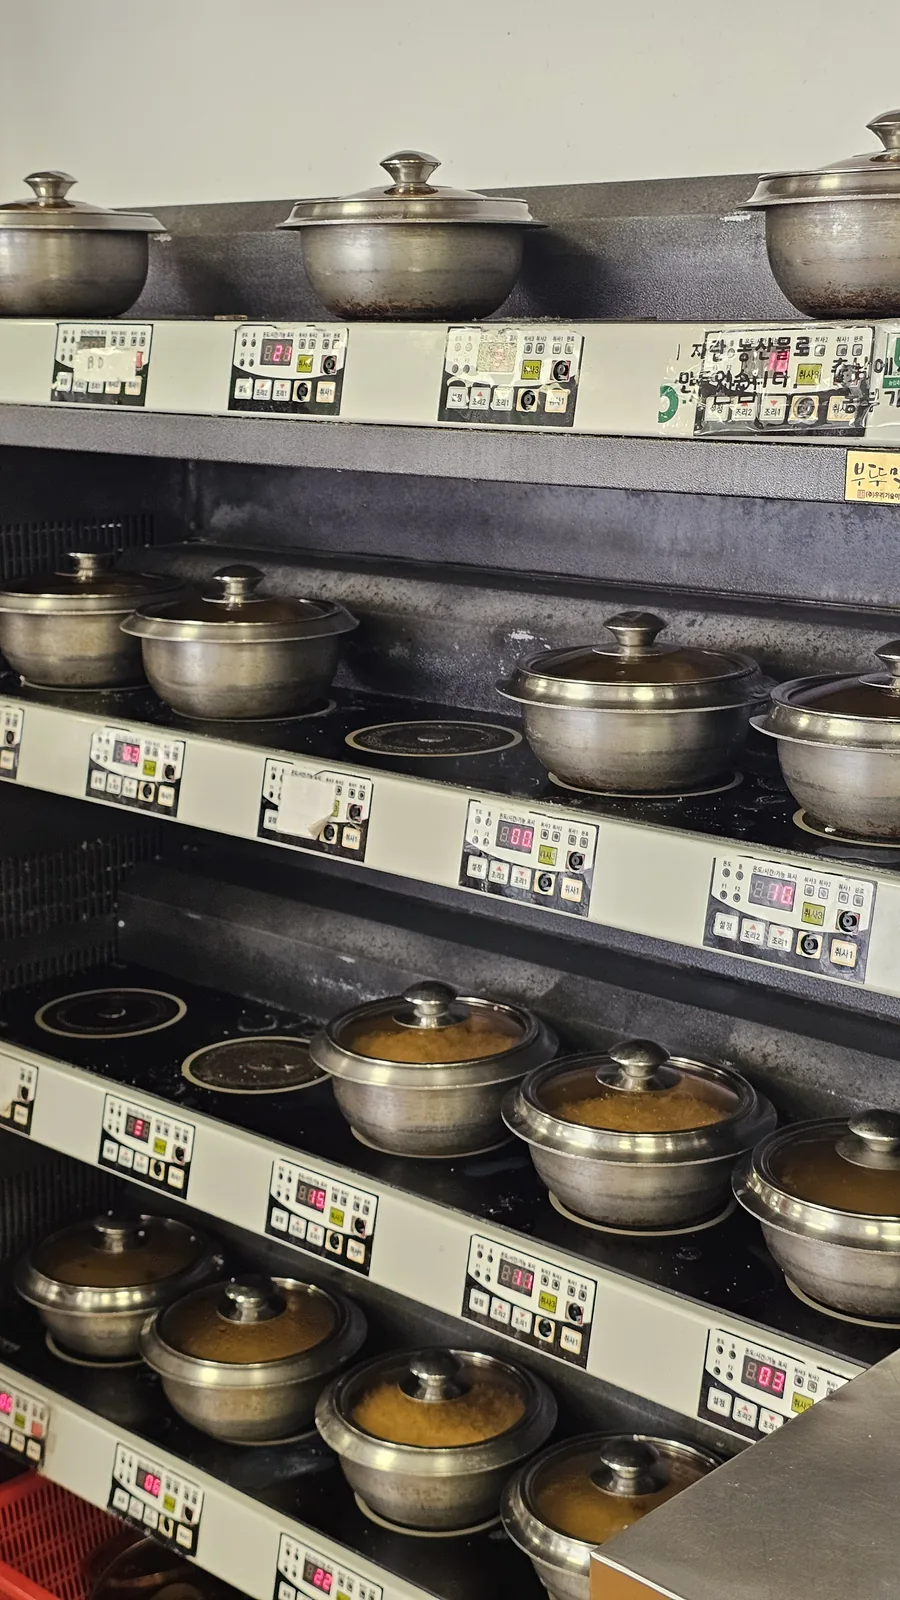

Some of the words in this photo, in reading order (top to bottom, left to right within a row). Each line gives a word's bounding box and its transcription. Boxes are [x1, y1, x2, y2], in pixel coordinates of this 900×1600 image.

[273, 345, 292, 361] 21
[496, 398, 509, 407] 조리1
[491, 871, 504, 880] 조리2
[514, 877, 526, 885] 조리1
[565, 886, 579, 894] 취사1
[838, 883, 851, 891] 취사1
[804, 907, 822, 919] 취사3
[719, 921, 733, 931] 설정
[744, 930, 760, 940] 조리2
[771, 936, 788, 947] 조리1
[835, 947, 853, 958] 취사1
[311, 1189, 325, 1209] 15
[516, 1270, 533, 1290] 11
[541, 1296, 555, 1308] 취사3
[564, 1335, 578, 1345] 취사1
[758, 1366, 785, 1392] 03
[713, 1396, 725, 1407] 설정
[737, 1410, 752, 1421] 조리2
[144, 1474, 160, 1496] 06
[313, 1568, 332, 1592] 22
